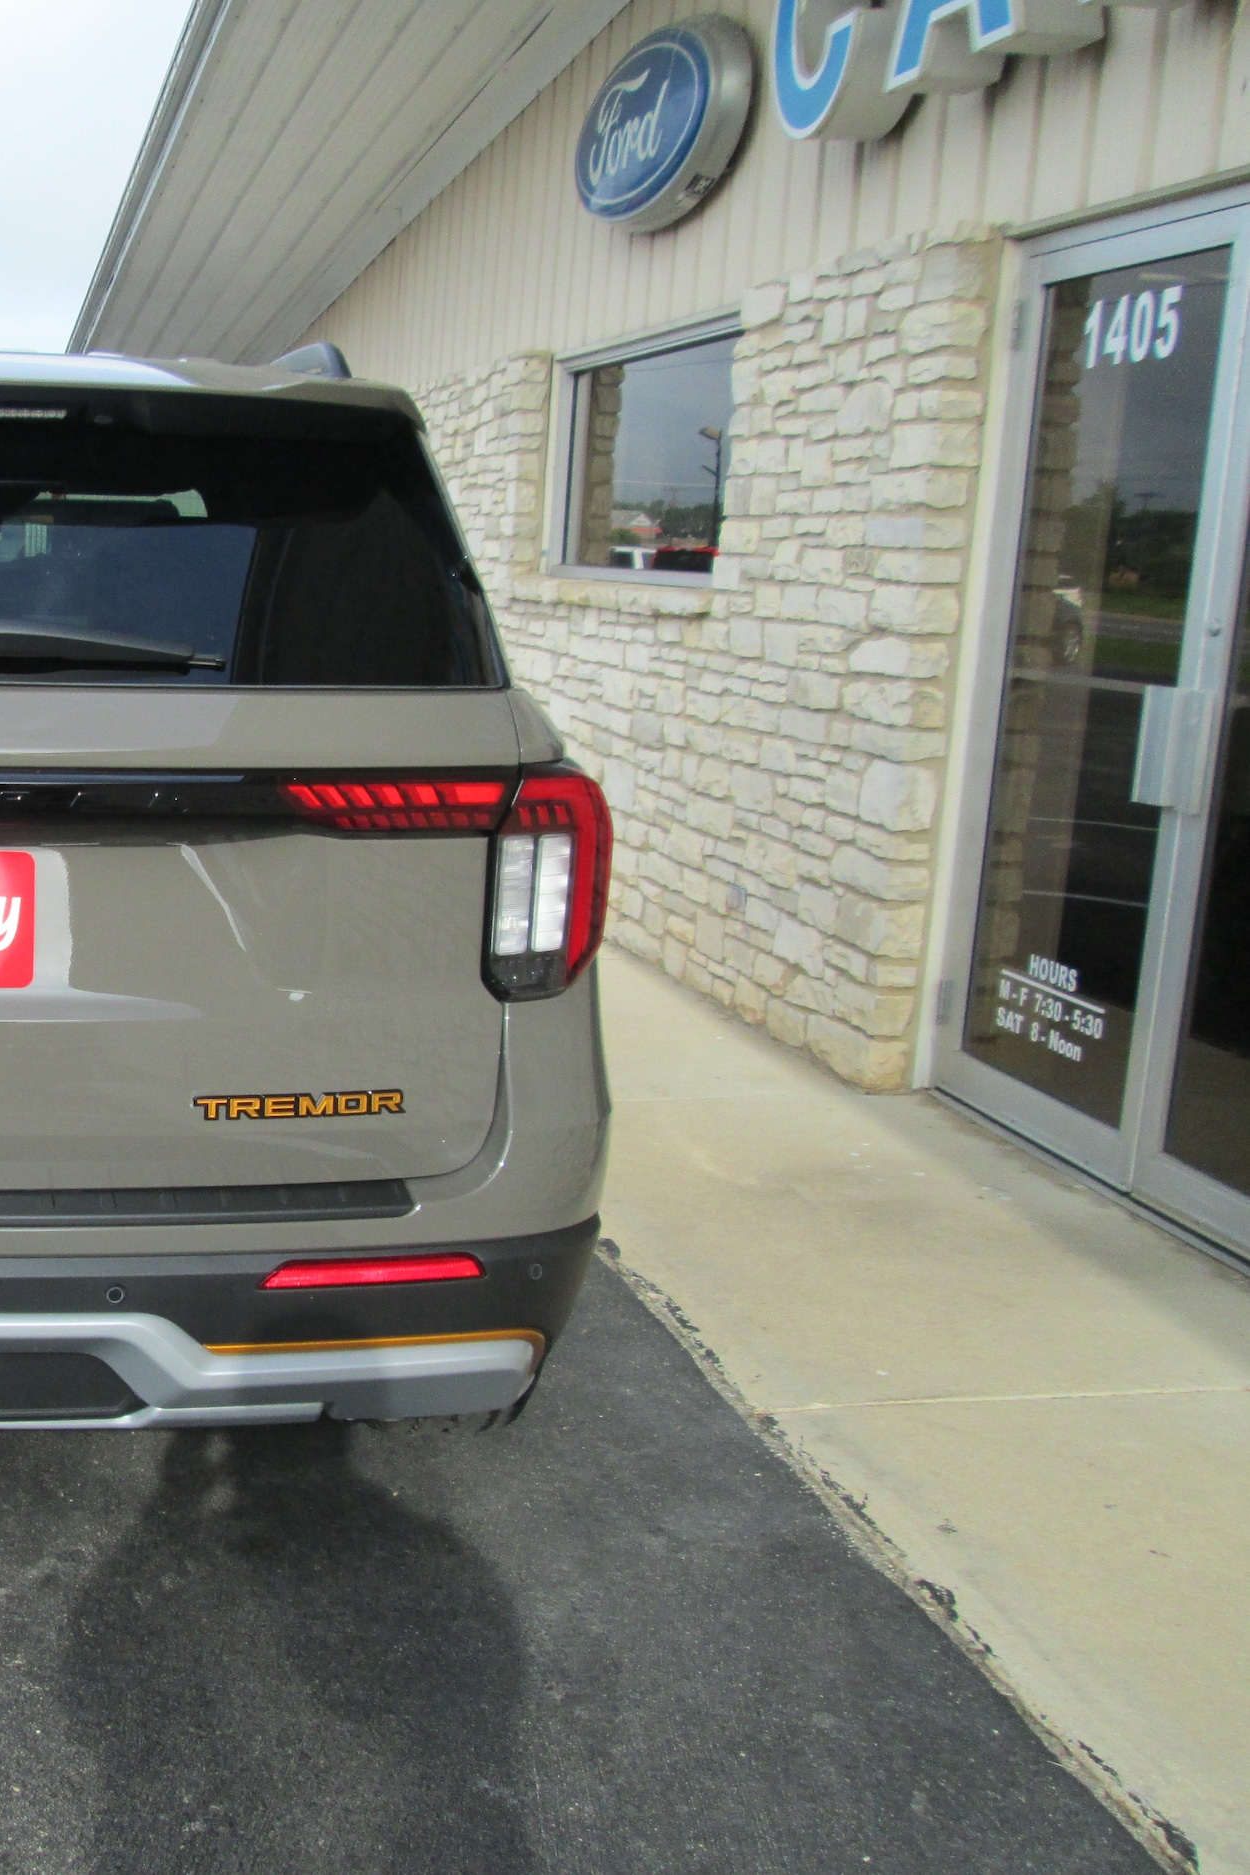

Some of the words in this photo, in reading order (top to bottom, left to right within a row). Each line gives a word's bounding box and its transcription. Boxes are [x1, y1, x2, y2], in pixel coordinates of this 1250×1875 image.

[589, 67, 669, 187] Ford
[1083, 284, 1184, 369] 1405
[1029, 953, 1078, 992] HOURS
[996, 1006, 1024, 1034] SAT
[194, 1090, 406, 1120] TREMOR
